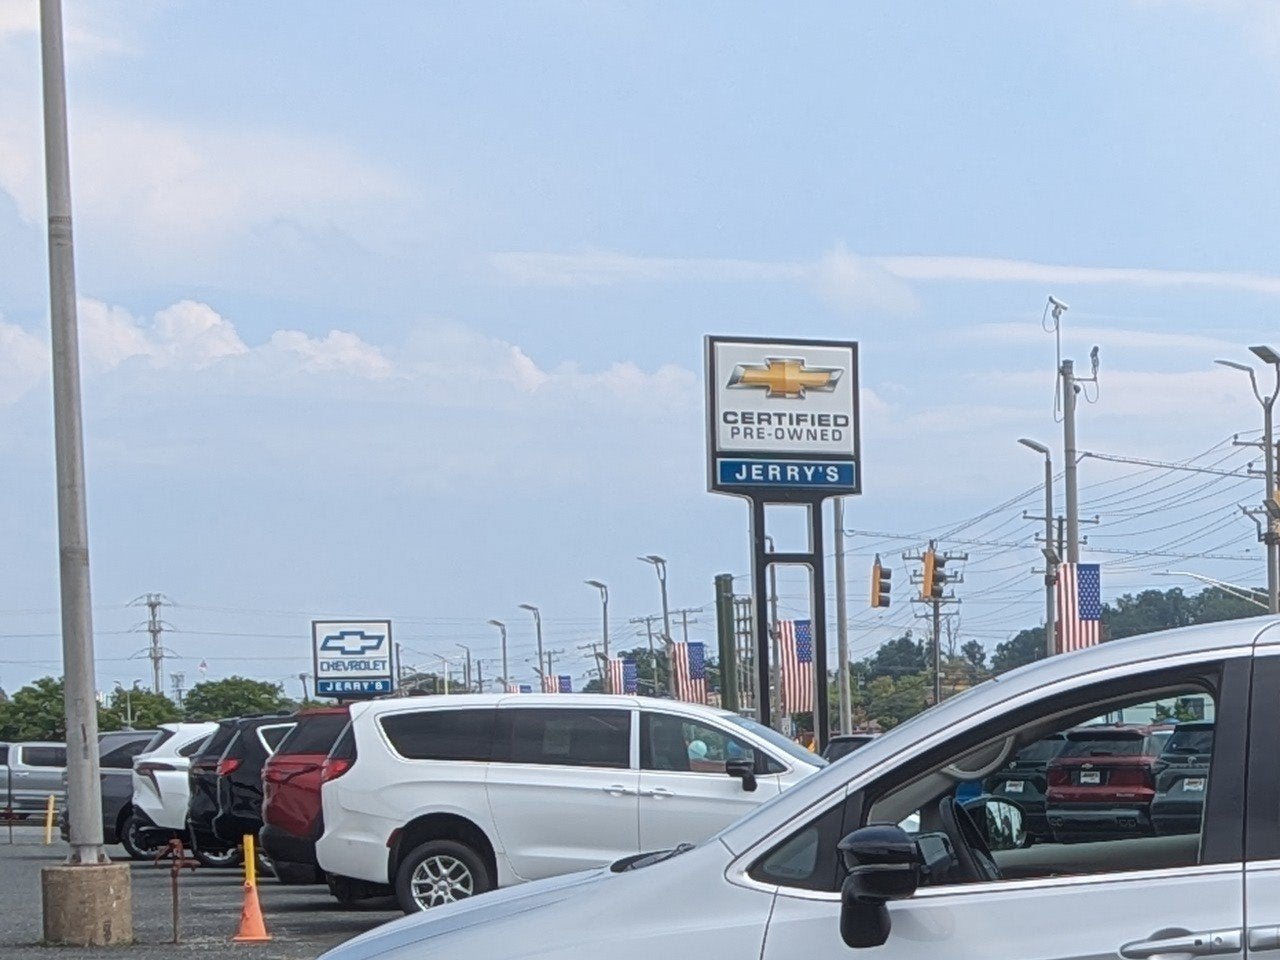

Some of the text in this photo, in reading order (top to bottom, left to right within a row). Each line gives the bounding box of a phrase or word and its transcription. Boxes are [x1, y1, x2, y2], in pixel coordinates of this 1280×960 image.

[722, 410, 849, 427] CERTIFIED
[730, 427, 843, 441] PRE-OWNED
[735, 464, 839, 482] JERRY'S
[320, 660, 387, 671] CHEVROLET
[326, 681, 383, 691] JERRY'S
